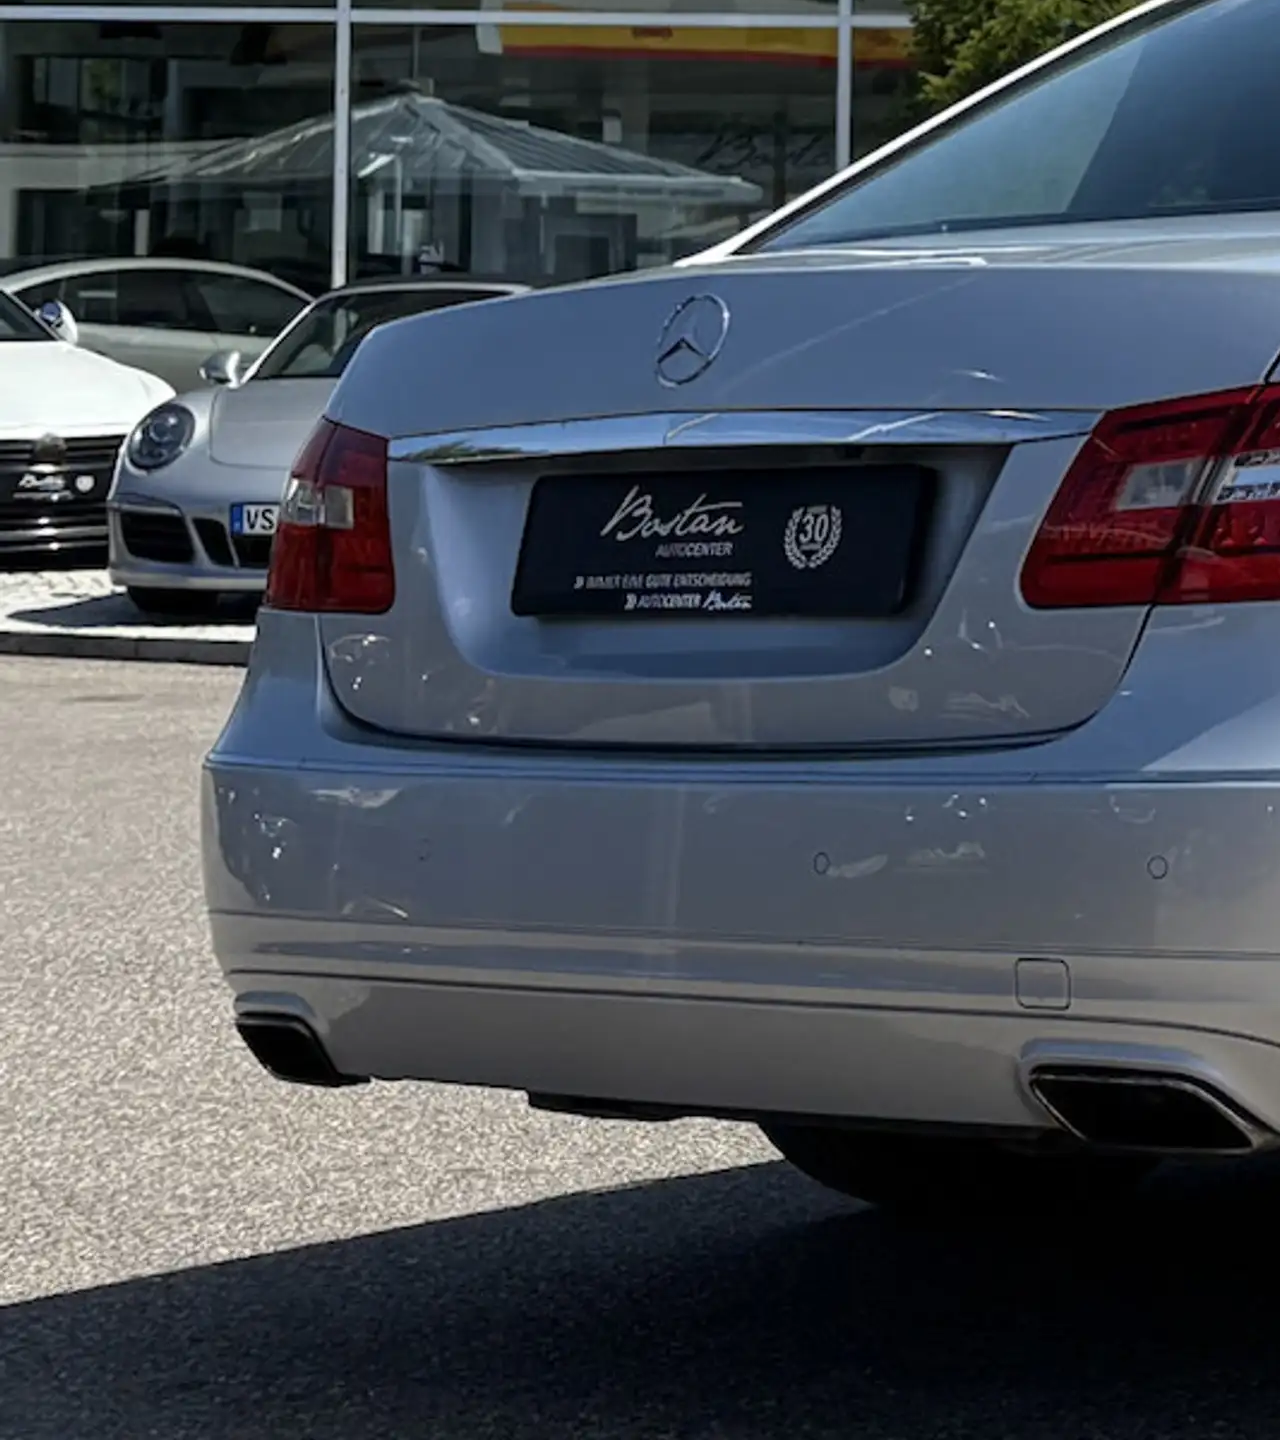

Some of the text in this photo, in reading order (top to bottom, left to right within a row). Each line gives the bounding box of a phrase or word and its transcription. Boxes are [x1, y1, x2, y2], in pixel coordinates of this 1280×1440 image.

[246, 509, 274, 530] VS
[600, 485, 744, 541] Bostan
[799, 513, 829, 543] 30
[655, 541, 733, 558] AUTOCENTER
